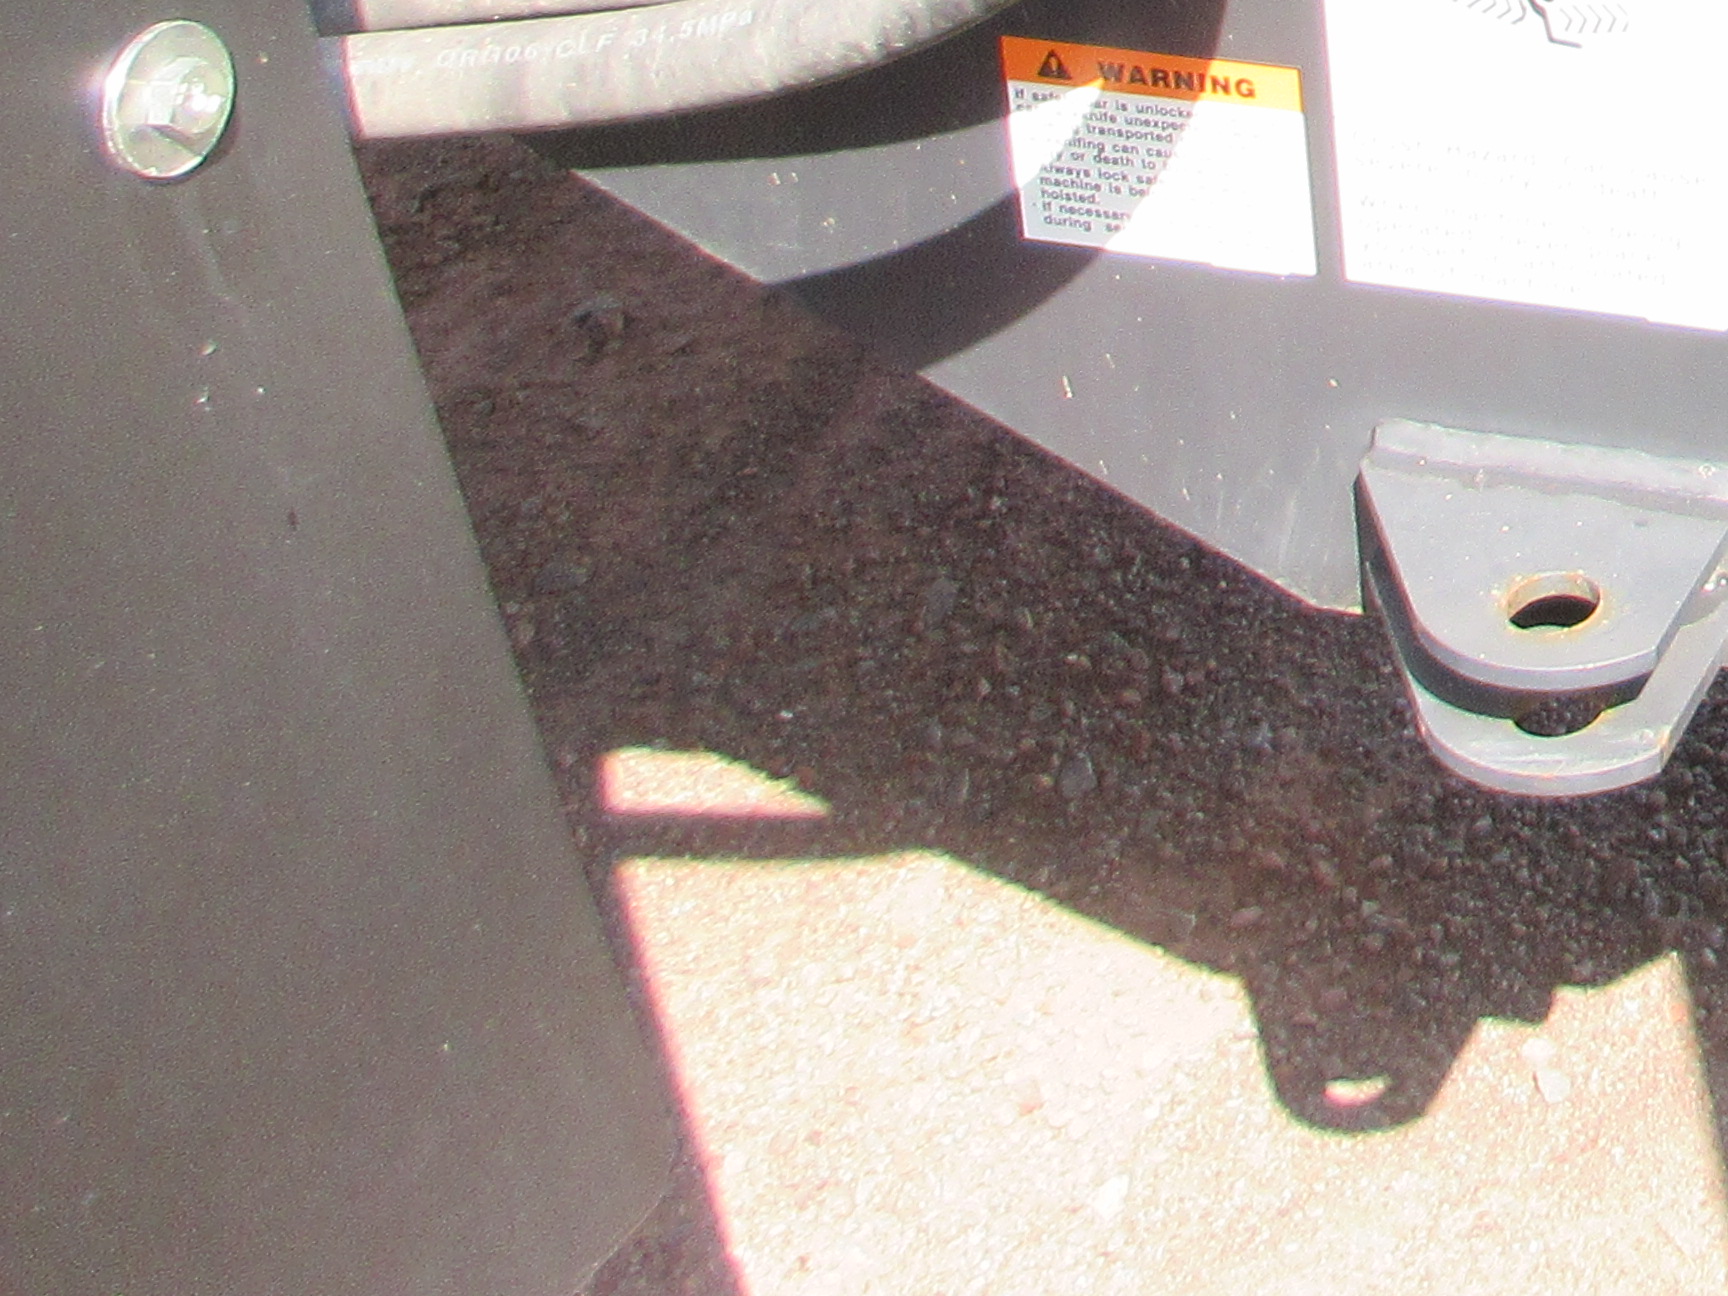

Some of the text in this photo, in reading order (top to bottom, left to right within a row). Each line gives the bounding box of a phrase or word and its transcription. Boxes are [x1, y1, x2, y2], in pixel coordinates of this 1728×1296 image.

[1097, 61, 1257, 99] WARNING
[1086, 123, 1174, 143] transported
[1112, 143, 1140, 155] can
[1093, 153, 1134, 168] death
[1097, 168, 1130, 182] lock
[1040, 176, 1101, 193] machine
[1043, 214, 1092, 232] during
